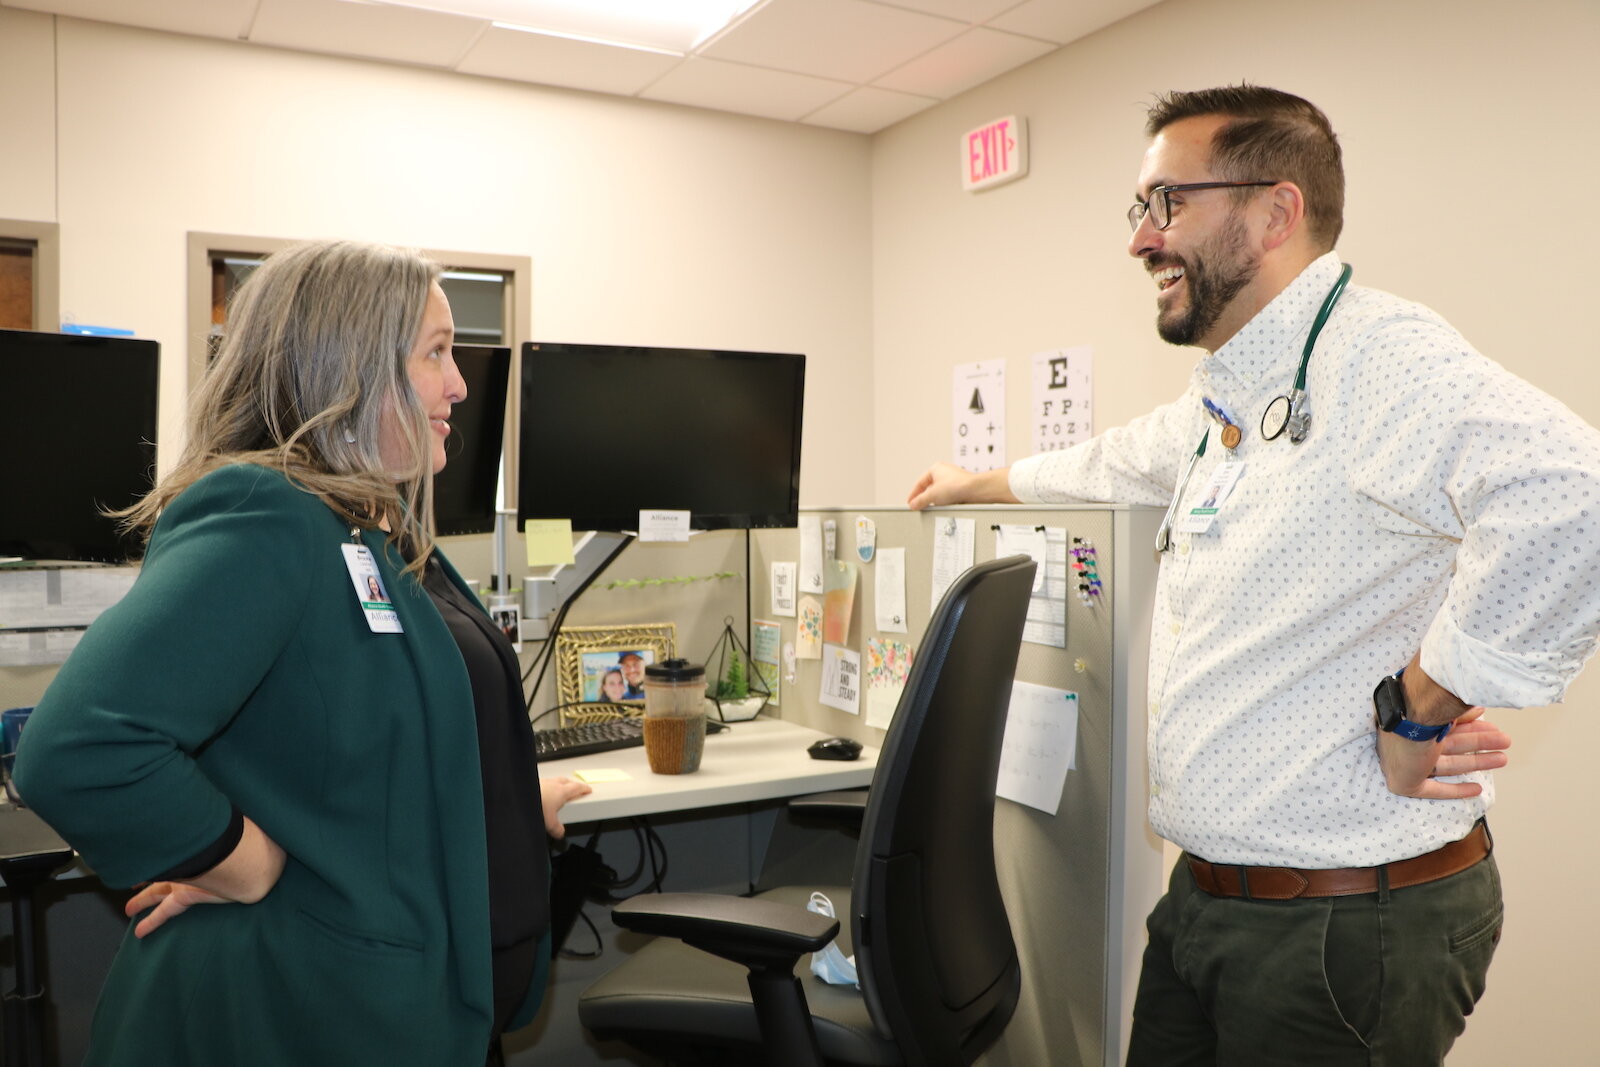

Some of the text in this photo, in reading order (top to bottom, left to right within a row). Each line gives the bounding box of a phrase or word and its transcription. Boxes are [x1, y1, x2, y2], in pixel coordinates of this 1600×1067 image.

[969, 120, 1008, 183] EXIT
[1048, 357, 1067, 389] E
[1043, 401, 1052, 416] F
[1062, 400, 1072, 415] P
[650, 514, 679, 522] Alliance
[371, 611, 398, 622] Allianc
[840, 660, 858, 676] STRONG
[840, 674, 850, 686] AND
[838, 686, 856, 702] STEADY
